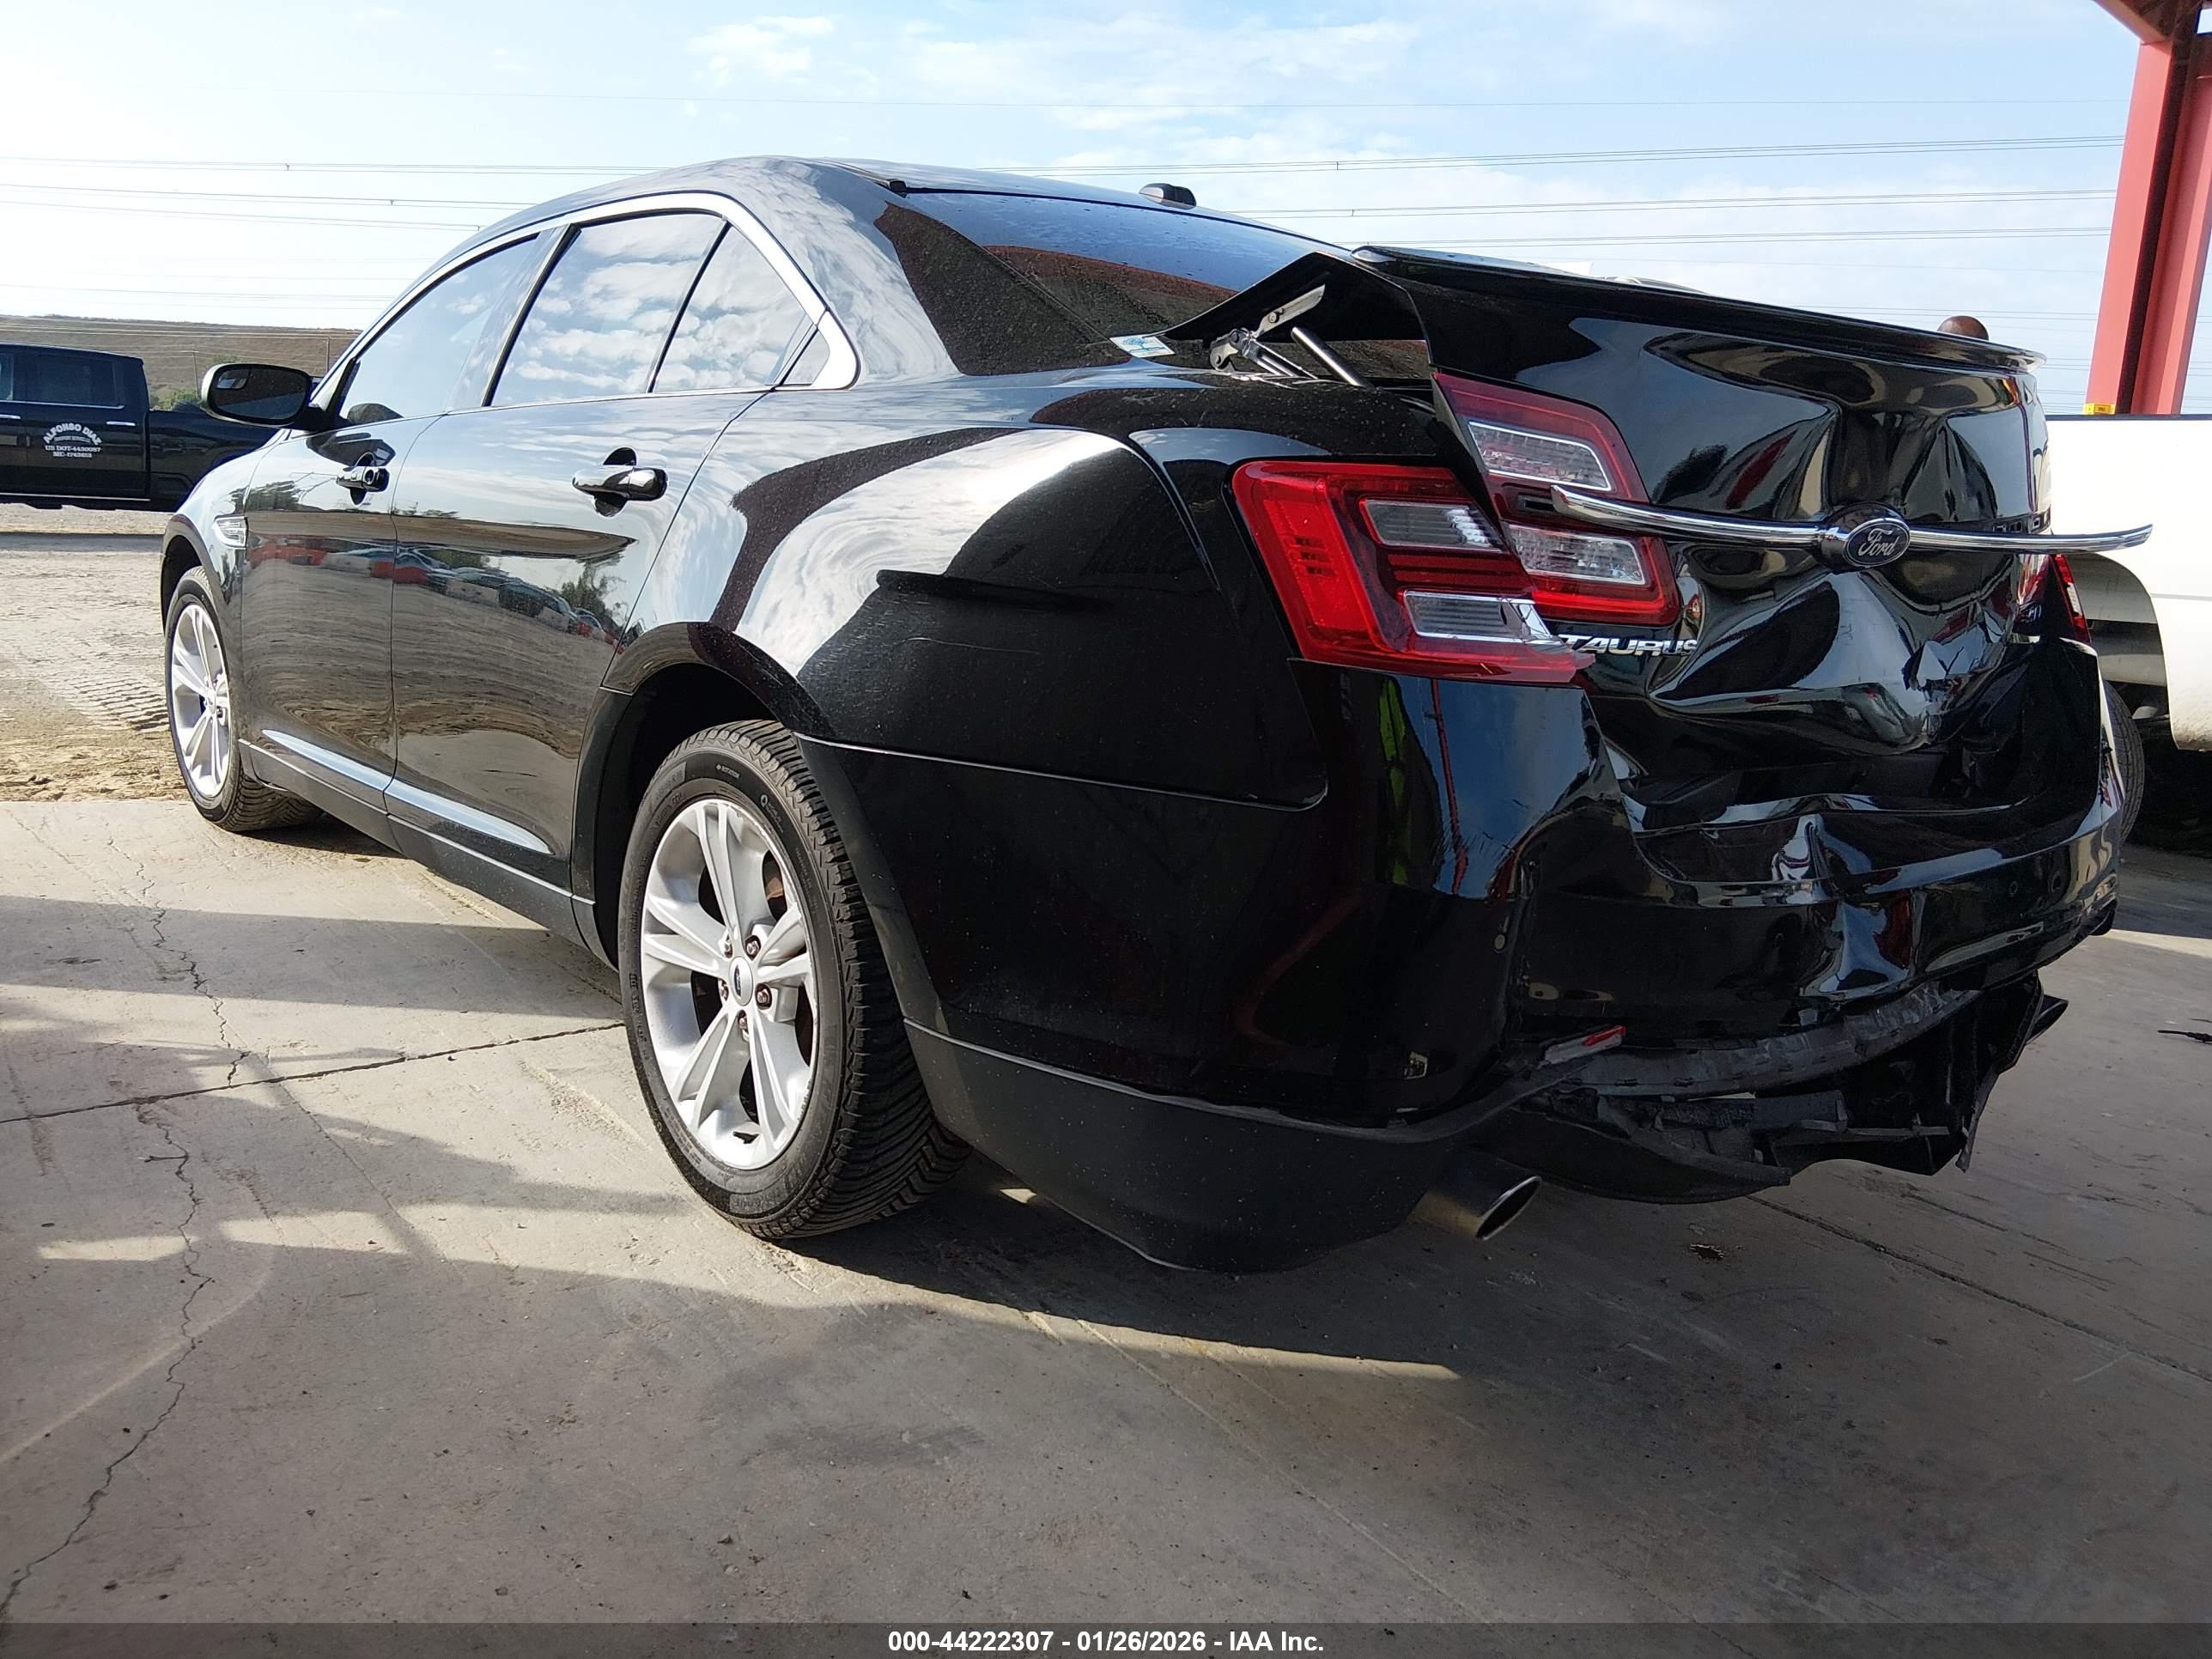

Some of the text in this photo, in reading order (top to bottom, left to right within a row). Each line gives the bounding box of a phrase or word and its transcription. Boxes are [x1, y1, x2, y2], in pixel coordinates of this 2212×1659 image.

[44, 422, 102, 445] ALFONSO DIAZ
[1857, 527, 1900, 556] Ford
[1558, 633, 1698, 657] TAURUS
